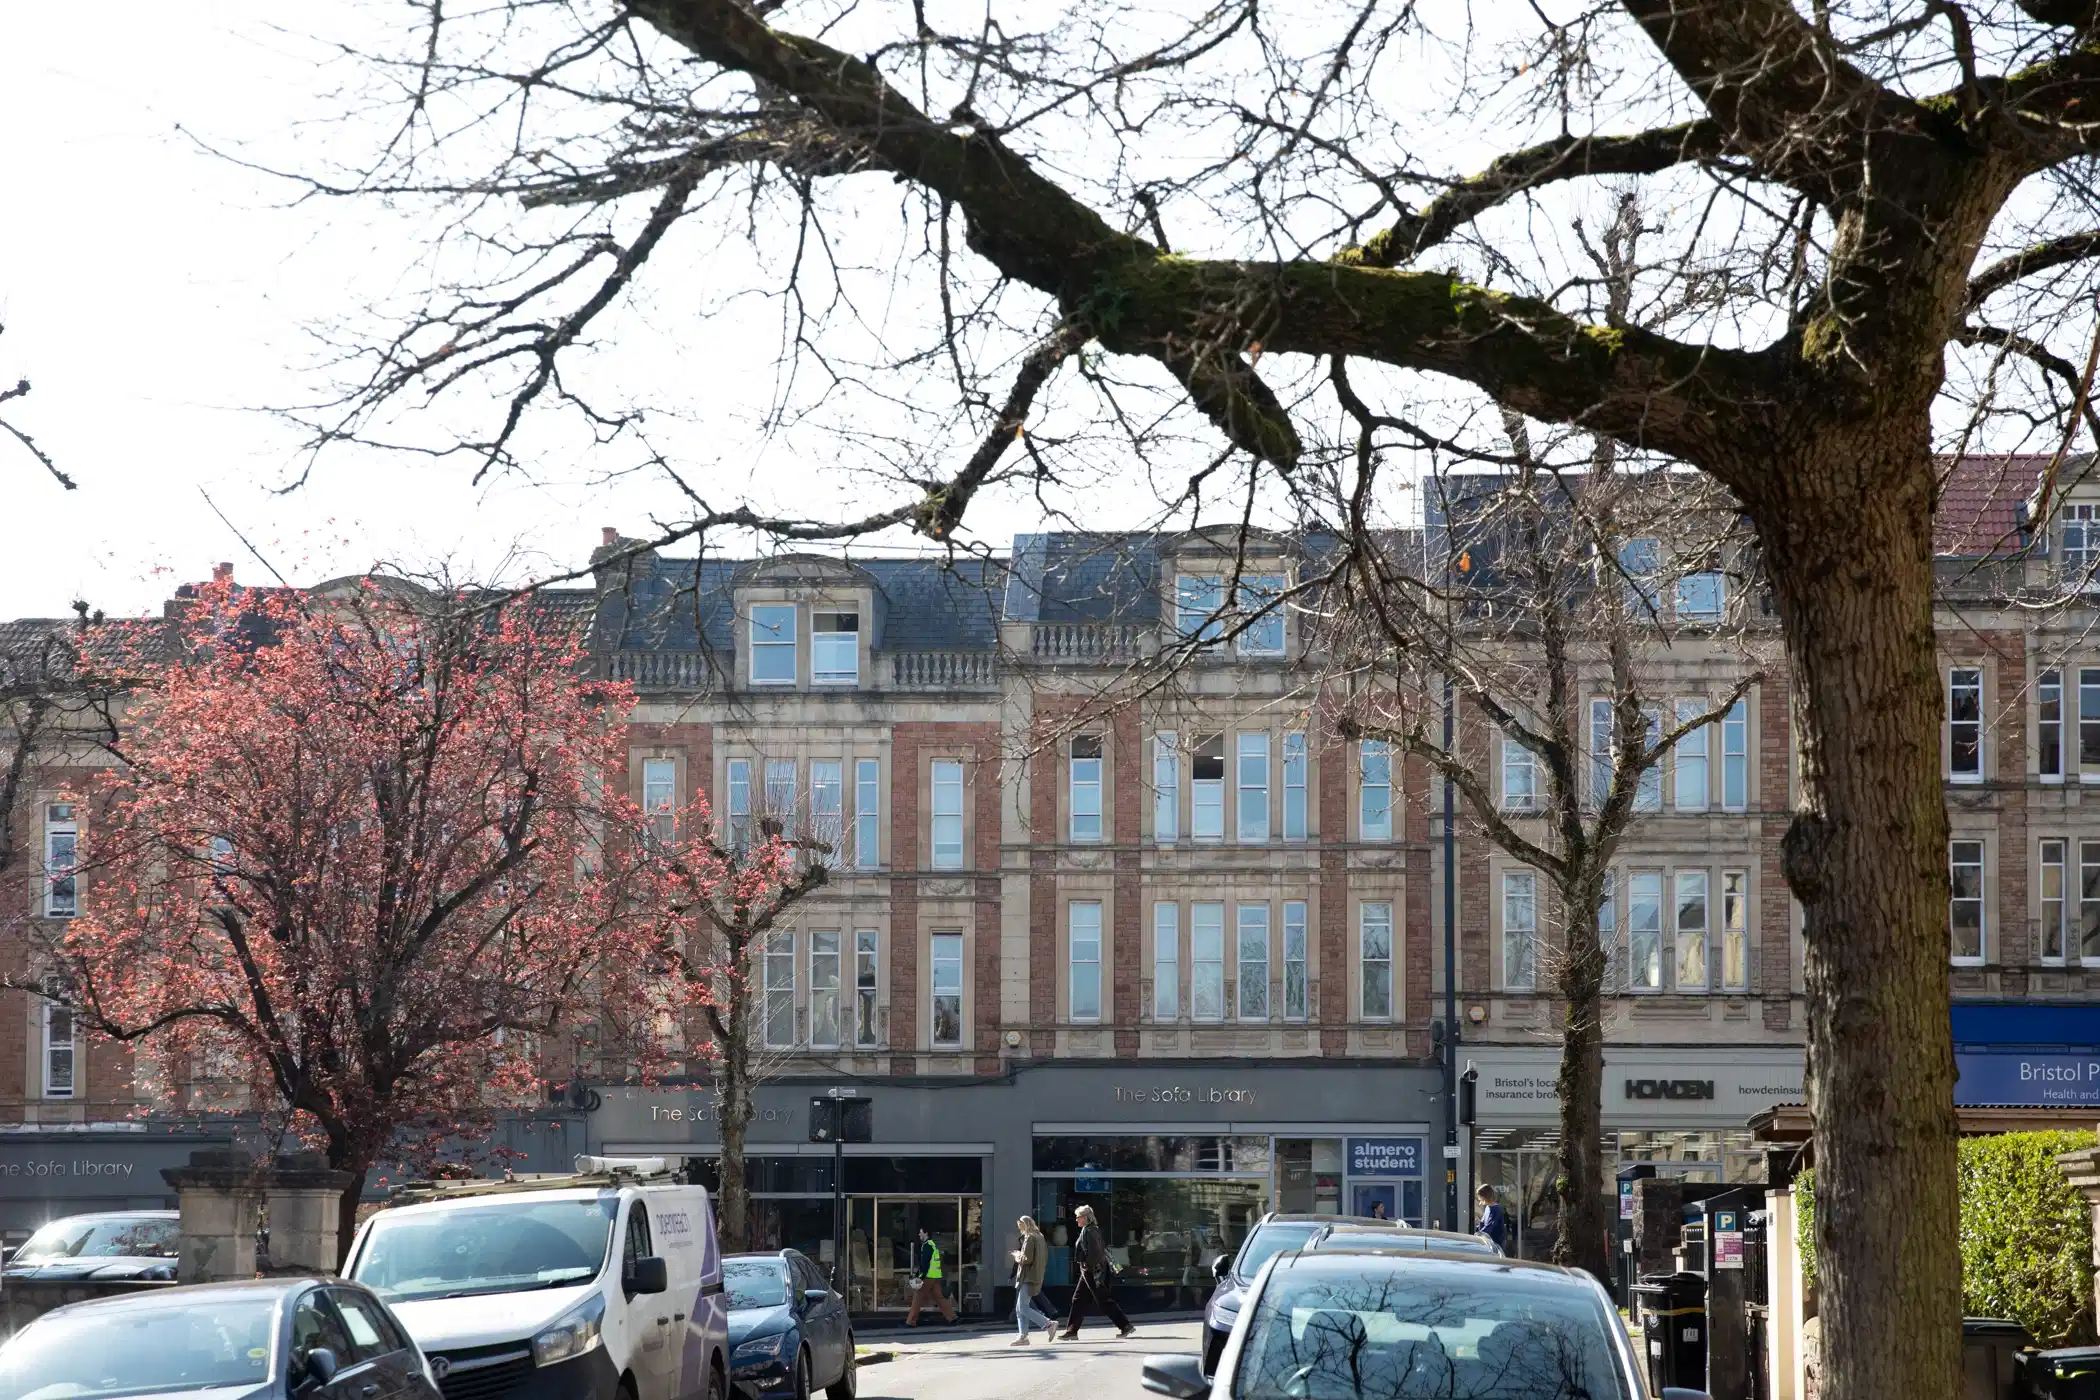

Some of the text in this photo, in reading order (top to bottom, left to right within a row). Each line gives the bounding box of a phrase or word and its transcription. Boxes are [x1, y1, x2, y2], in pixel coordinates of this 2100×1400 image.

[2020, 1062, 2081, 1081] Bristol
[1495, 1078, 1558, 1088] Bristol's loca
[1625, 1079, 1715, 1100] HOWDEN
[1114, 1086, 1257, 1104] The Sofa Library
[1485, 1090, 1559, 1099] insurance brok
[2043, 1087, 2099, 1099] Health and
[650, 1105, 682, 1121] The
[1354, 1142, 1415, 1156] almero
[25, 1160, 66, 1176] Sofa
[73, 1160, 133, 1179] Library
[1354, 1156, 1415, 1169] student
[1623, 1183, 1630, 1193] P
[1720, 1214, 1733, 1229] P
